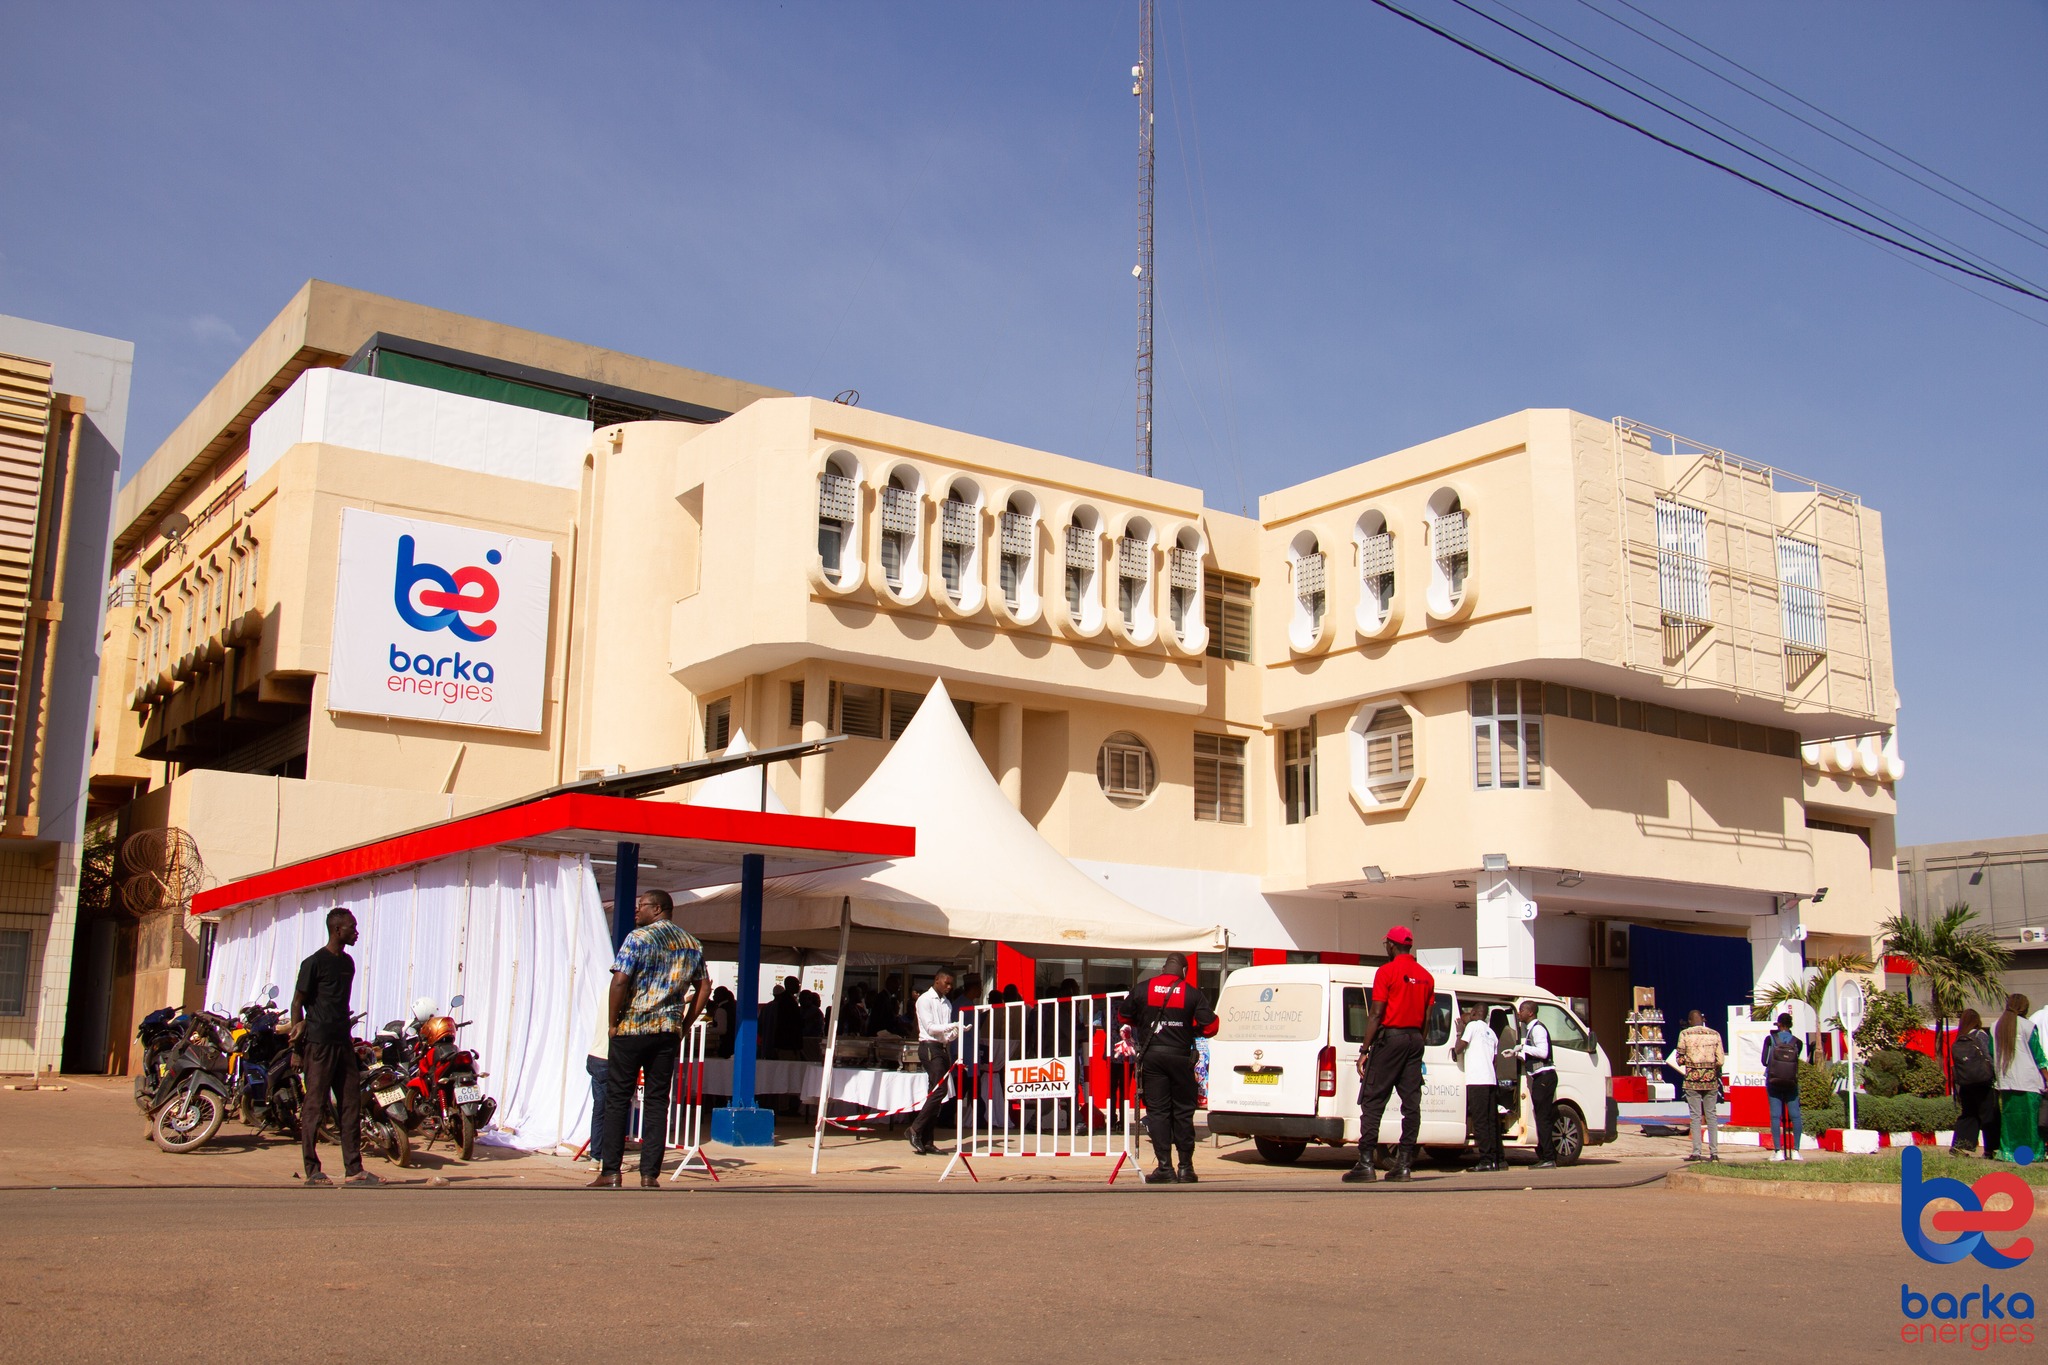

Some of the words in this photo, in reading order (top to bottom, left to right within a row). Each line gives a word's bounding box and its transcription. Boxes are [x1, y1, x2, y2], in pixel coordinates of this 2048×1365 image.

[389, 643, 494, 684] barka
[387, 675, 493, 704] energies
[1524, 903, 1533, 918] 3
[1227, 1006, 1260, 1022] SOPATEL
[1263, 1005, 1303, 1022] SILMANDE
[1010, 1061, 1066, 1084] TIEND
[1732, 1075, 1742, 1086] A
[1007, 1081, 1070, 1093] COMPANY
[457, 1092, 481, 1103] 8905
